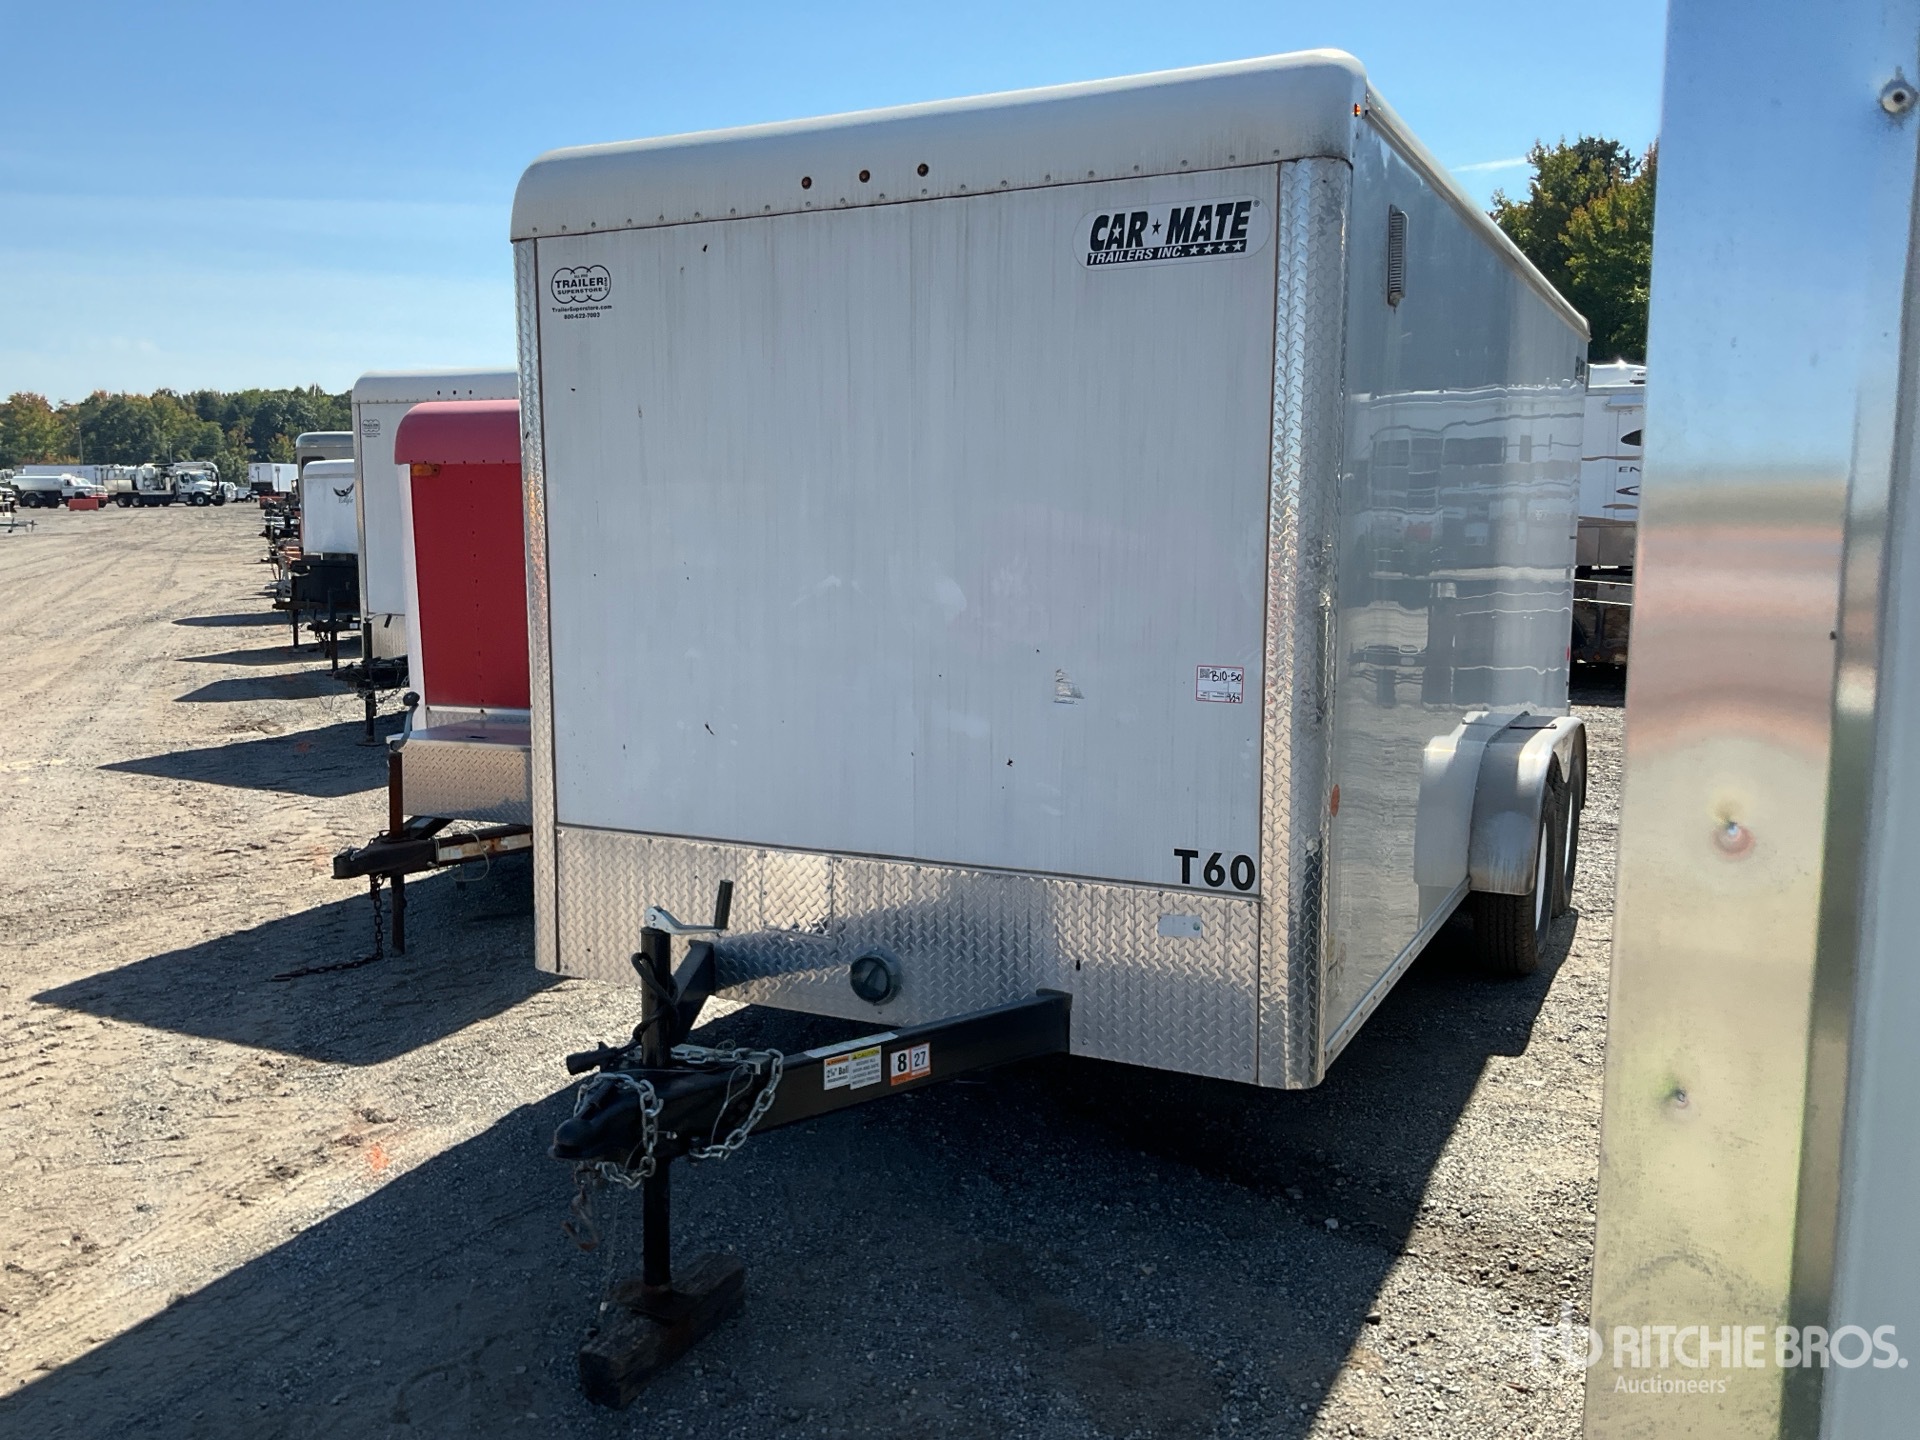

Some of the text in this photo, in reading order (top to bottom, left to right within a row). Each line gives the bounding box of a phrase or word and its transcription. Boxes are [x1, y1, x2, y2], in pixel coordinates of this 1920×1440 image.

[1089, 200, 1252, 252] CAR MATE
[1089, 246, 1185, 265] TRAILERS INC.
[555, 277, 604, 289] TRAILER
[557, 287, 602, 295] SUPERSTORE
[1173, 848, 1256, 891] T60
[897, 1052, 907, 1072] 8
[914, 1050, 927, 1067] 27
